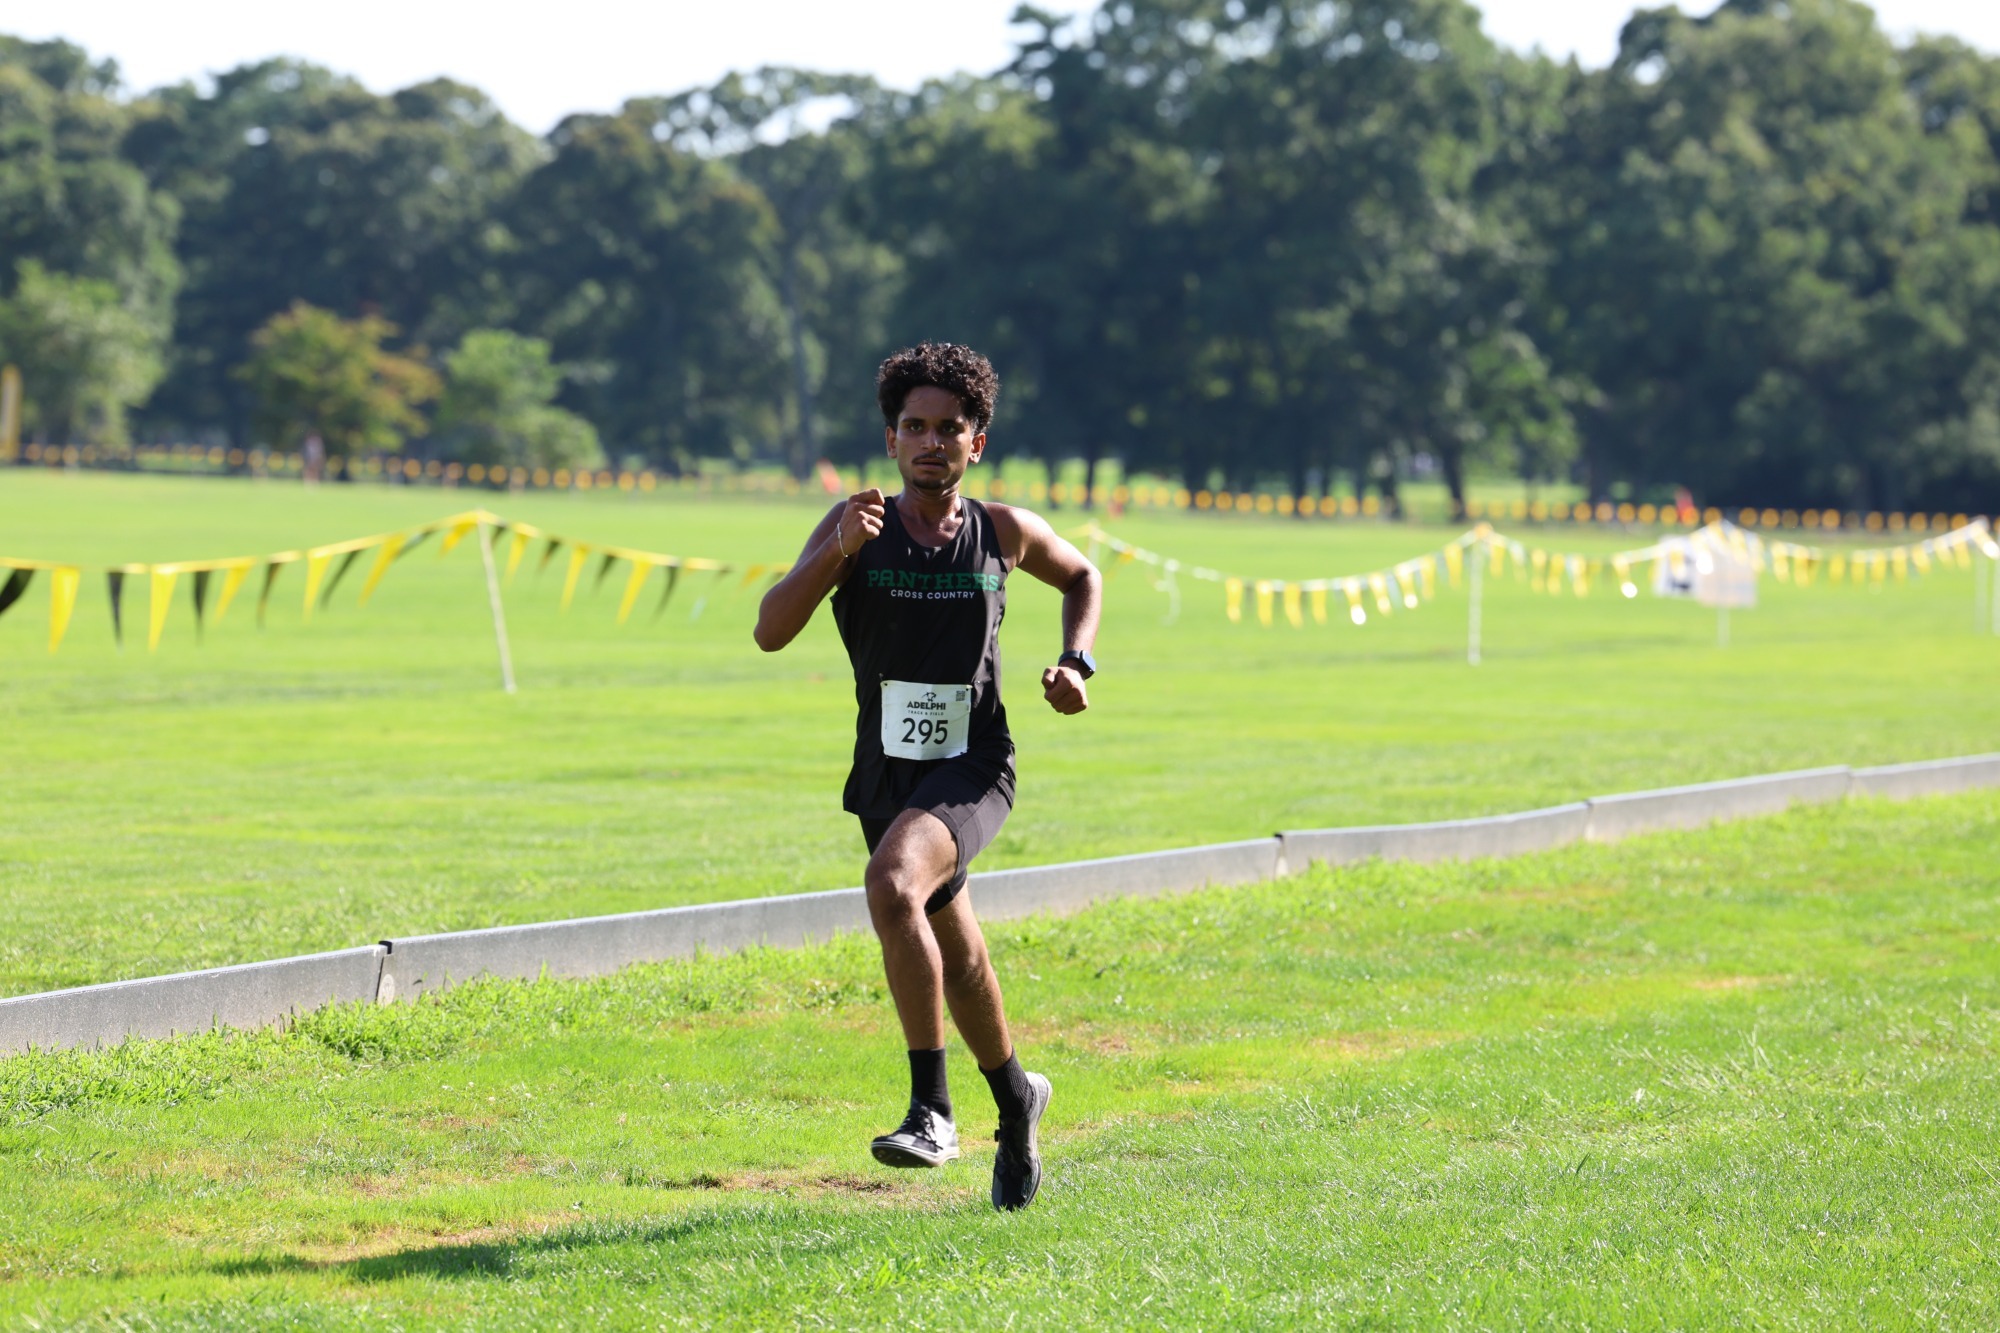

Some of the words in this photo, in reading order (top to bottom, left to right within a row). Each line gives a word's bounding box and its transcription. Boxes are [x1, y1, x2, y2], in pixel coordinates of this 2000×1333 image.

[867, 569, 999, 592] PANTHERS
[890, 589, 923, 599] CROSS
[926, 591, 975, 600] COUNTRY
[907, 701, 946, 710] ADELPHI
[901, 717, 948, 745] 295
